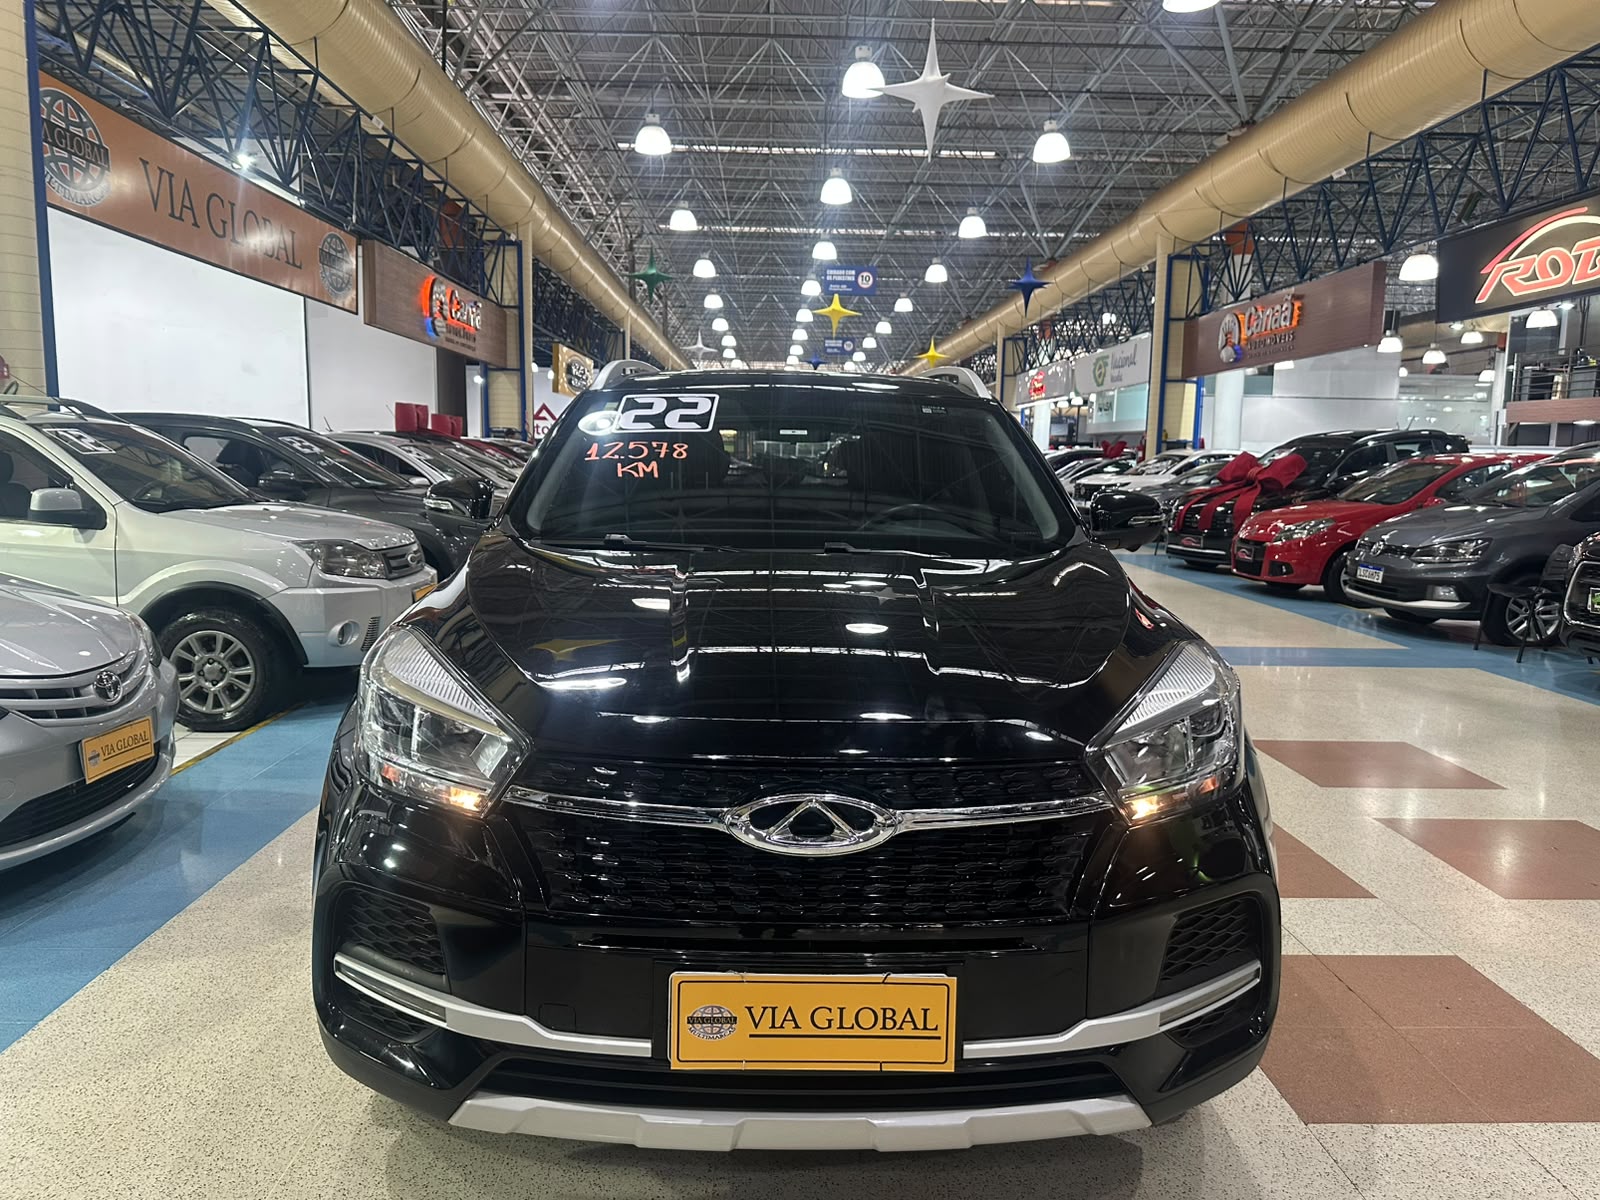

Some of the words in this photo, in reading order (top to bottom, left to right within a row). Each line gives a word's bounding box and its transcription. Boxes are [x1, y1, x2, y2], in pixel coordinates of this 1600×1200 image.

[139, 157, 200, 229] VIA
[206, 193, 303, 270] GLOBAL
[860, 274, 871, 283] 10
[619, 397, 712, 430] 22
[584, 441, 689, 461] 12.578
[616, 460, 659, 479] KM
[101, 743, 116, 757] VIA
[116, 730, 149, 752] GLOBAL
[744, 1005, 803, 1030] VIA
[809, 1005, 939, 1032] GLOBAL
